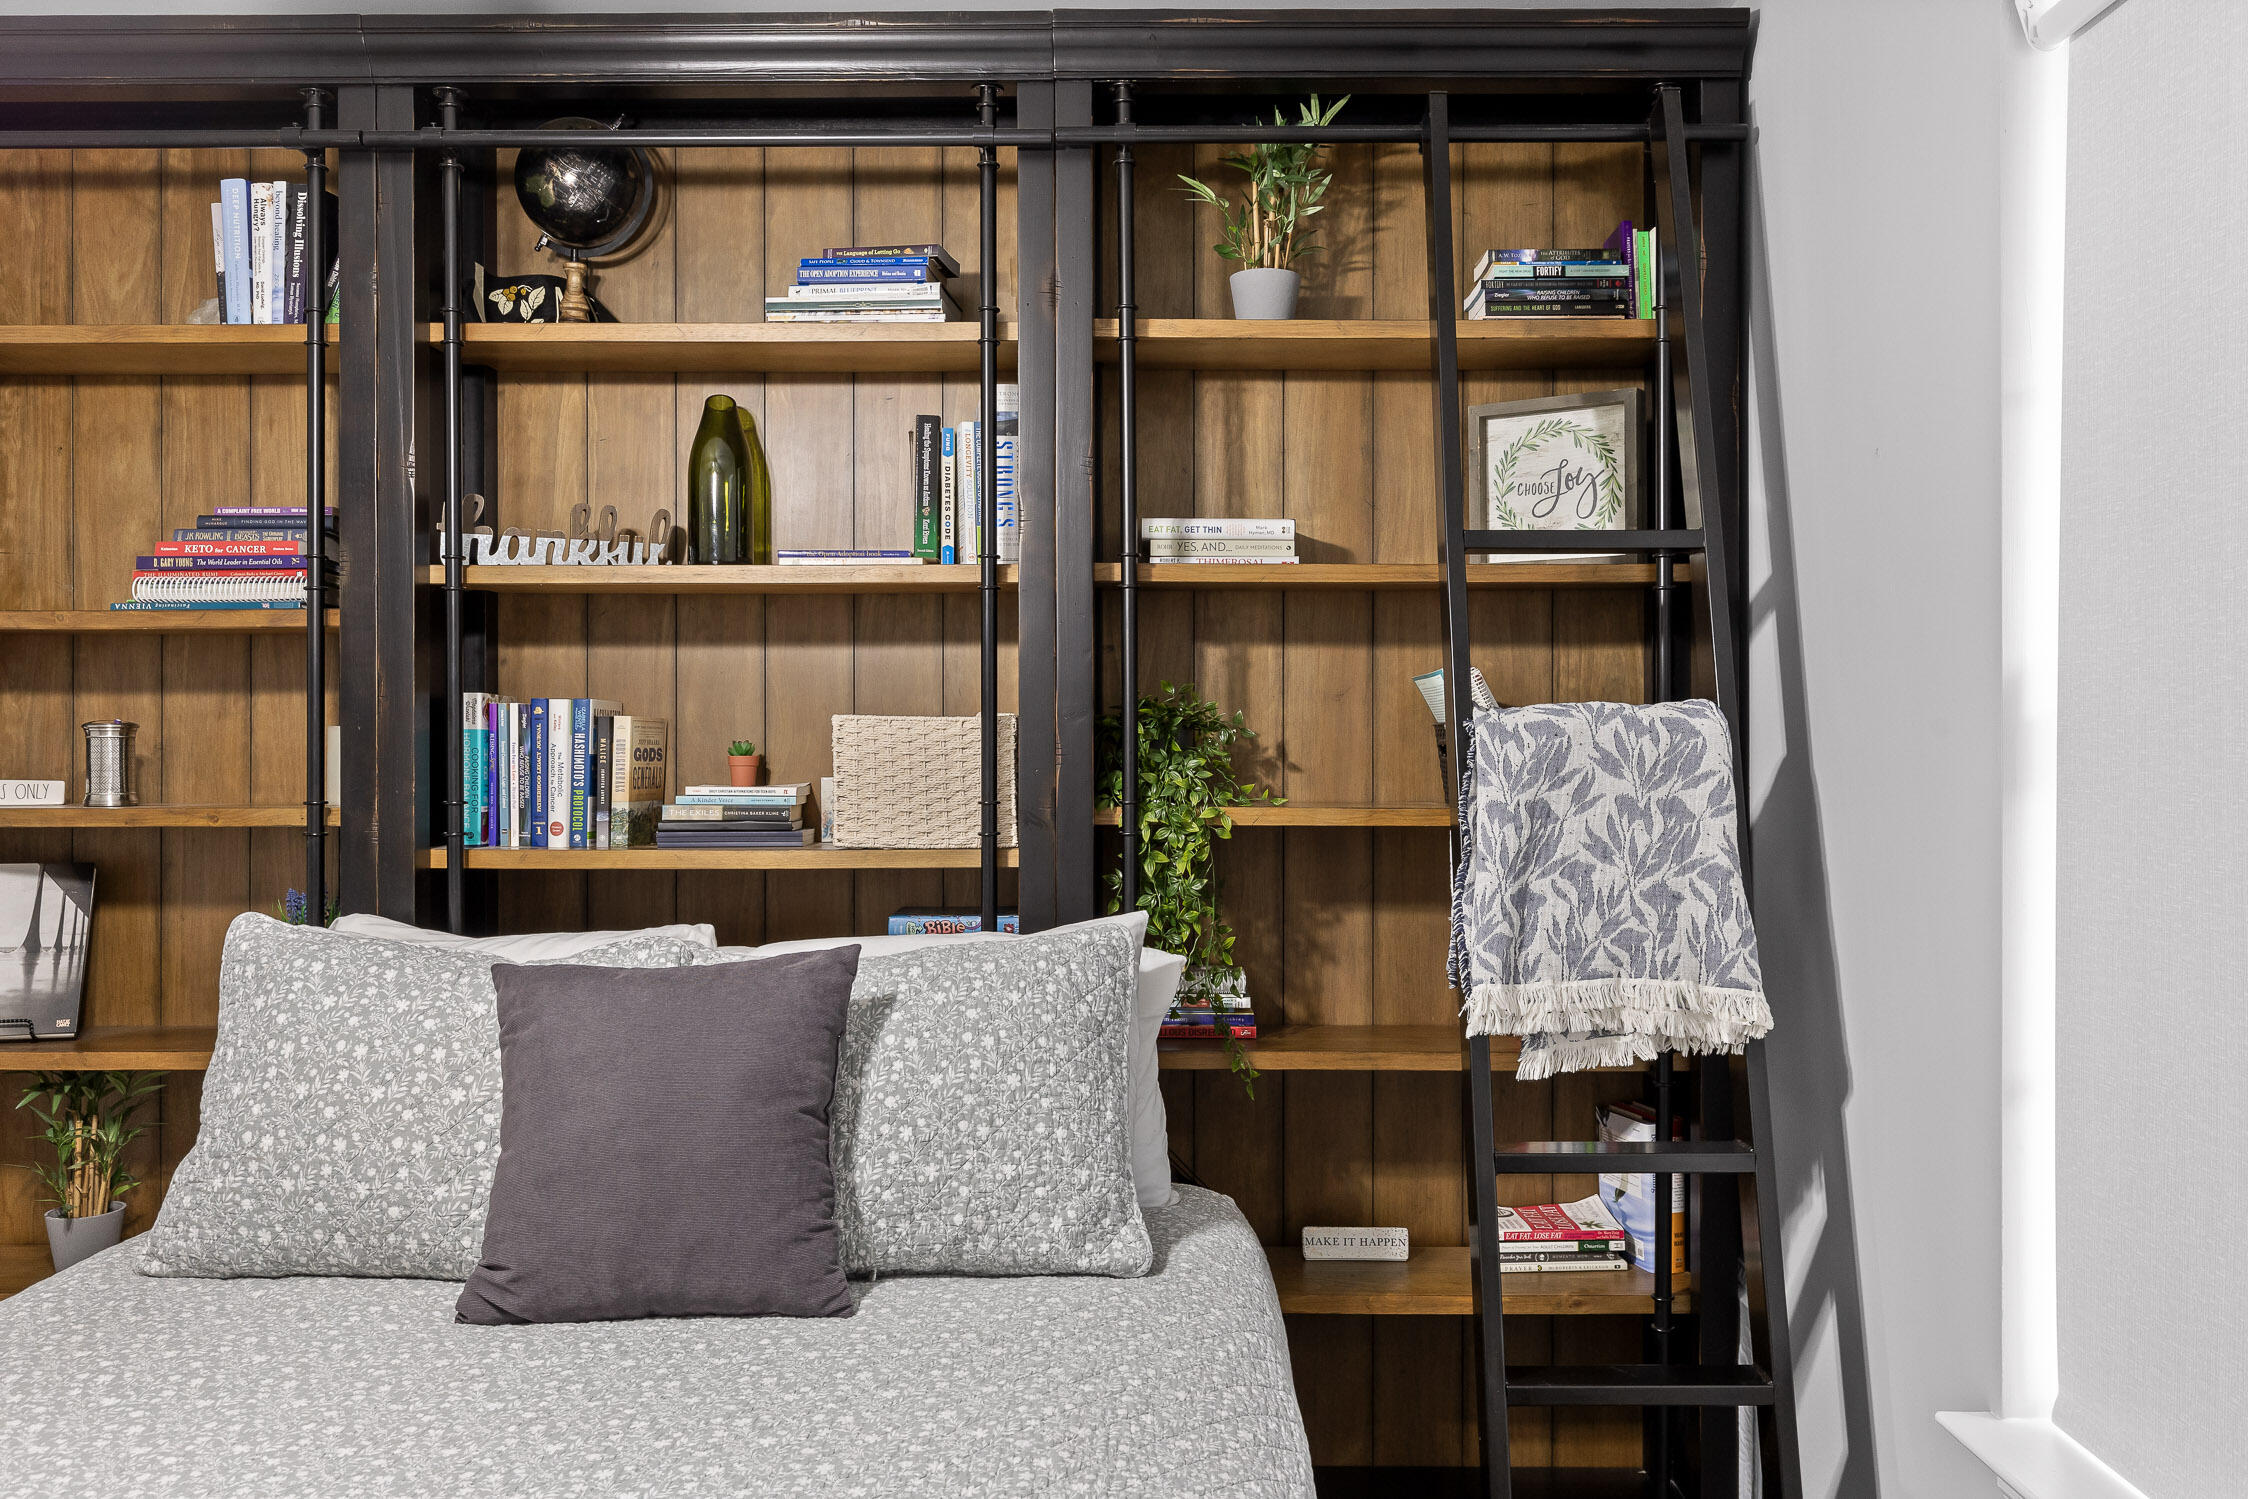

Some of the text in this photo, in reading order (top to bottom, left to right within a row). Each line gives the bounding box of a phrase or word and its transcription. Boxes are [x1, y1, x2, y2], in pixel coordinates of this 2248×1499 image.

[232, 188, 240, 209] DEEP
[273, 190, 284, 250] beyond healing
[232, 211, 241, 259] NUTRITION
[293, 192, 308, 278] Dissolving Illusions
[1536, 267, 1562, 276] FORTIFY
[924, 423, 932, 439] Healing
[997, 441, 1015, 527] STRONG'S
[1518, 483, 1555, 496] CHOOSE
[1532, 459, 1604, 519] Joy
[966, 479, 974, 519] SOLUTION
[195, 531, 224, 540] ROWLING
[1166, 526, 1182, 534] FAT,
[184, 545, 213, 553] KETO
[1177, 542, 1198, 552] YES,
[154, 558, 193, 567] D. GARY YOUNG
[634, 748, 663, 762] GODS
[471, 747, 479, 813] COOKING FOR
[572, 733, 585, 831] HASHIMOTO'S PROTOCOL
[633, 766, 662, 790] GENERALS
[15, 784, 49, 799] ONLY
[1305, 1237, 1406, 1246] MAKE IT HAPPEN
